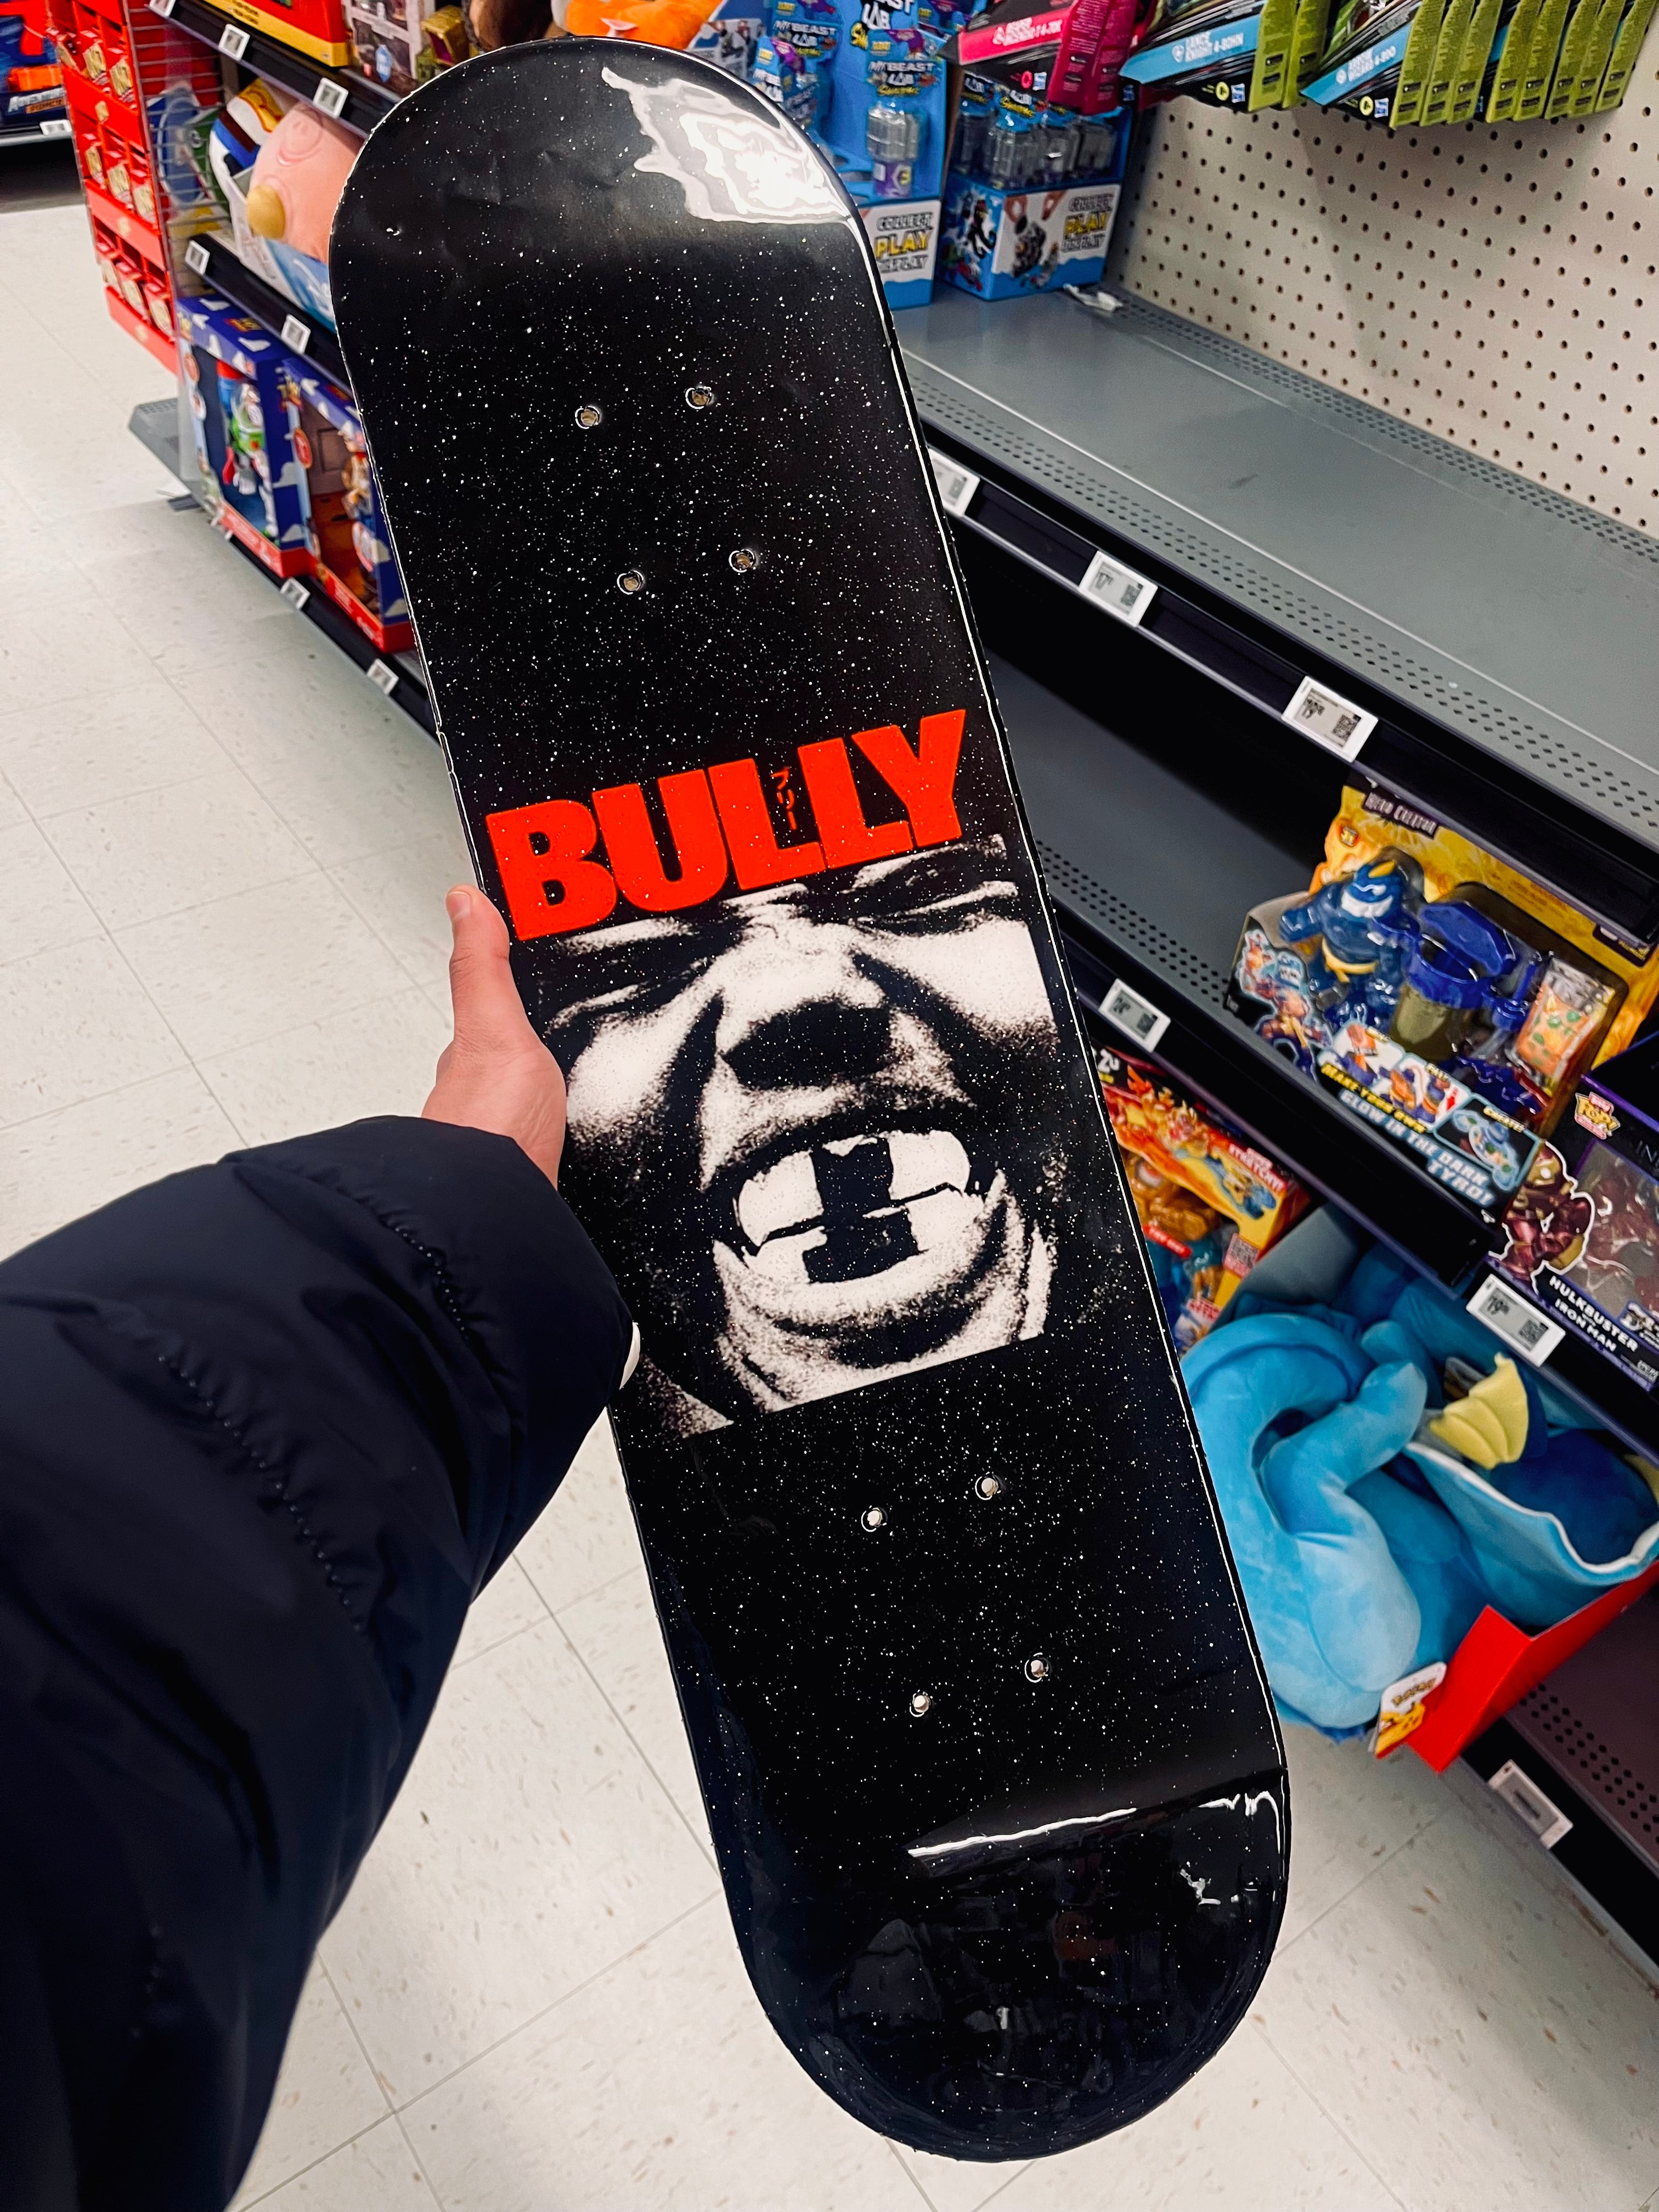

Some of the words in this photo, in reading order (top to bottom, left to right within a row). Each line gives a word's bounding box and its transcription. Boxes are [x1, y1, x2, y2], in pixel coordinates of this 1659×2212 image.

[862, 1, 891, 30] LAB
[874, 230, 932, 261] PLAY
[1063, 212, 1110, 239] PLAY
[486, 709, 966, 941] BULLY
[1340, 1089, 1386, 1124] GLOW
[1385, 1118, 1407, 1137] IN
[1407, 1132, 1437, 1158] THE
[1437, 1151, 1489, 1186] DARK
[1427, 1160, 1495, 1206] TYRO!
[1549, 1275, 1639, 1352] HULKBUSTER
[1554, 1298, 1587, 1329] IRON
[1586, 1324, 1617, 1352] MAN
